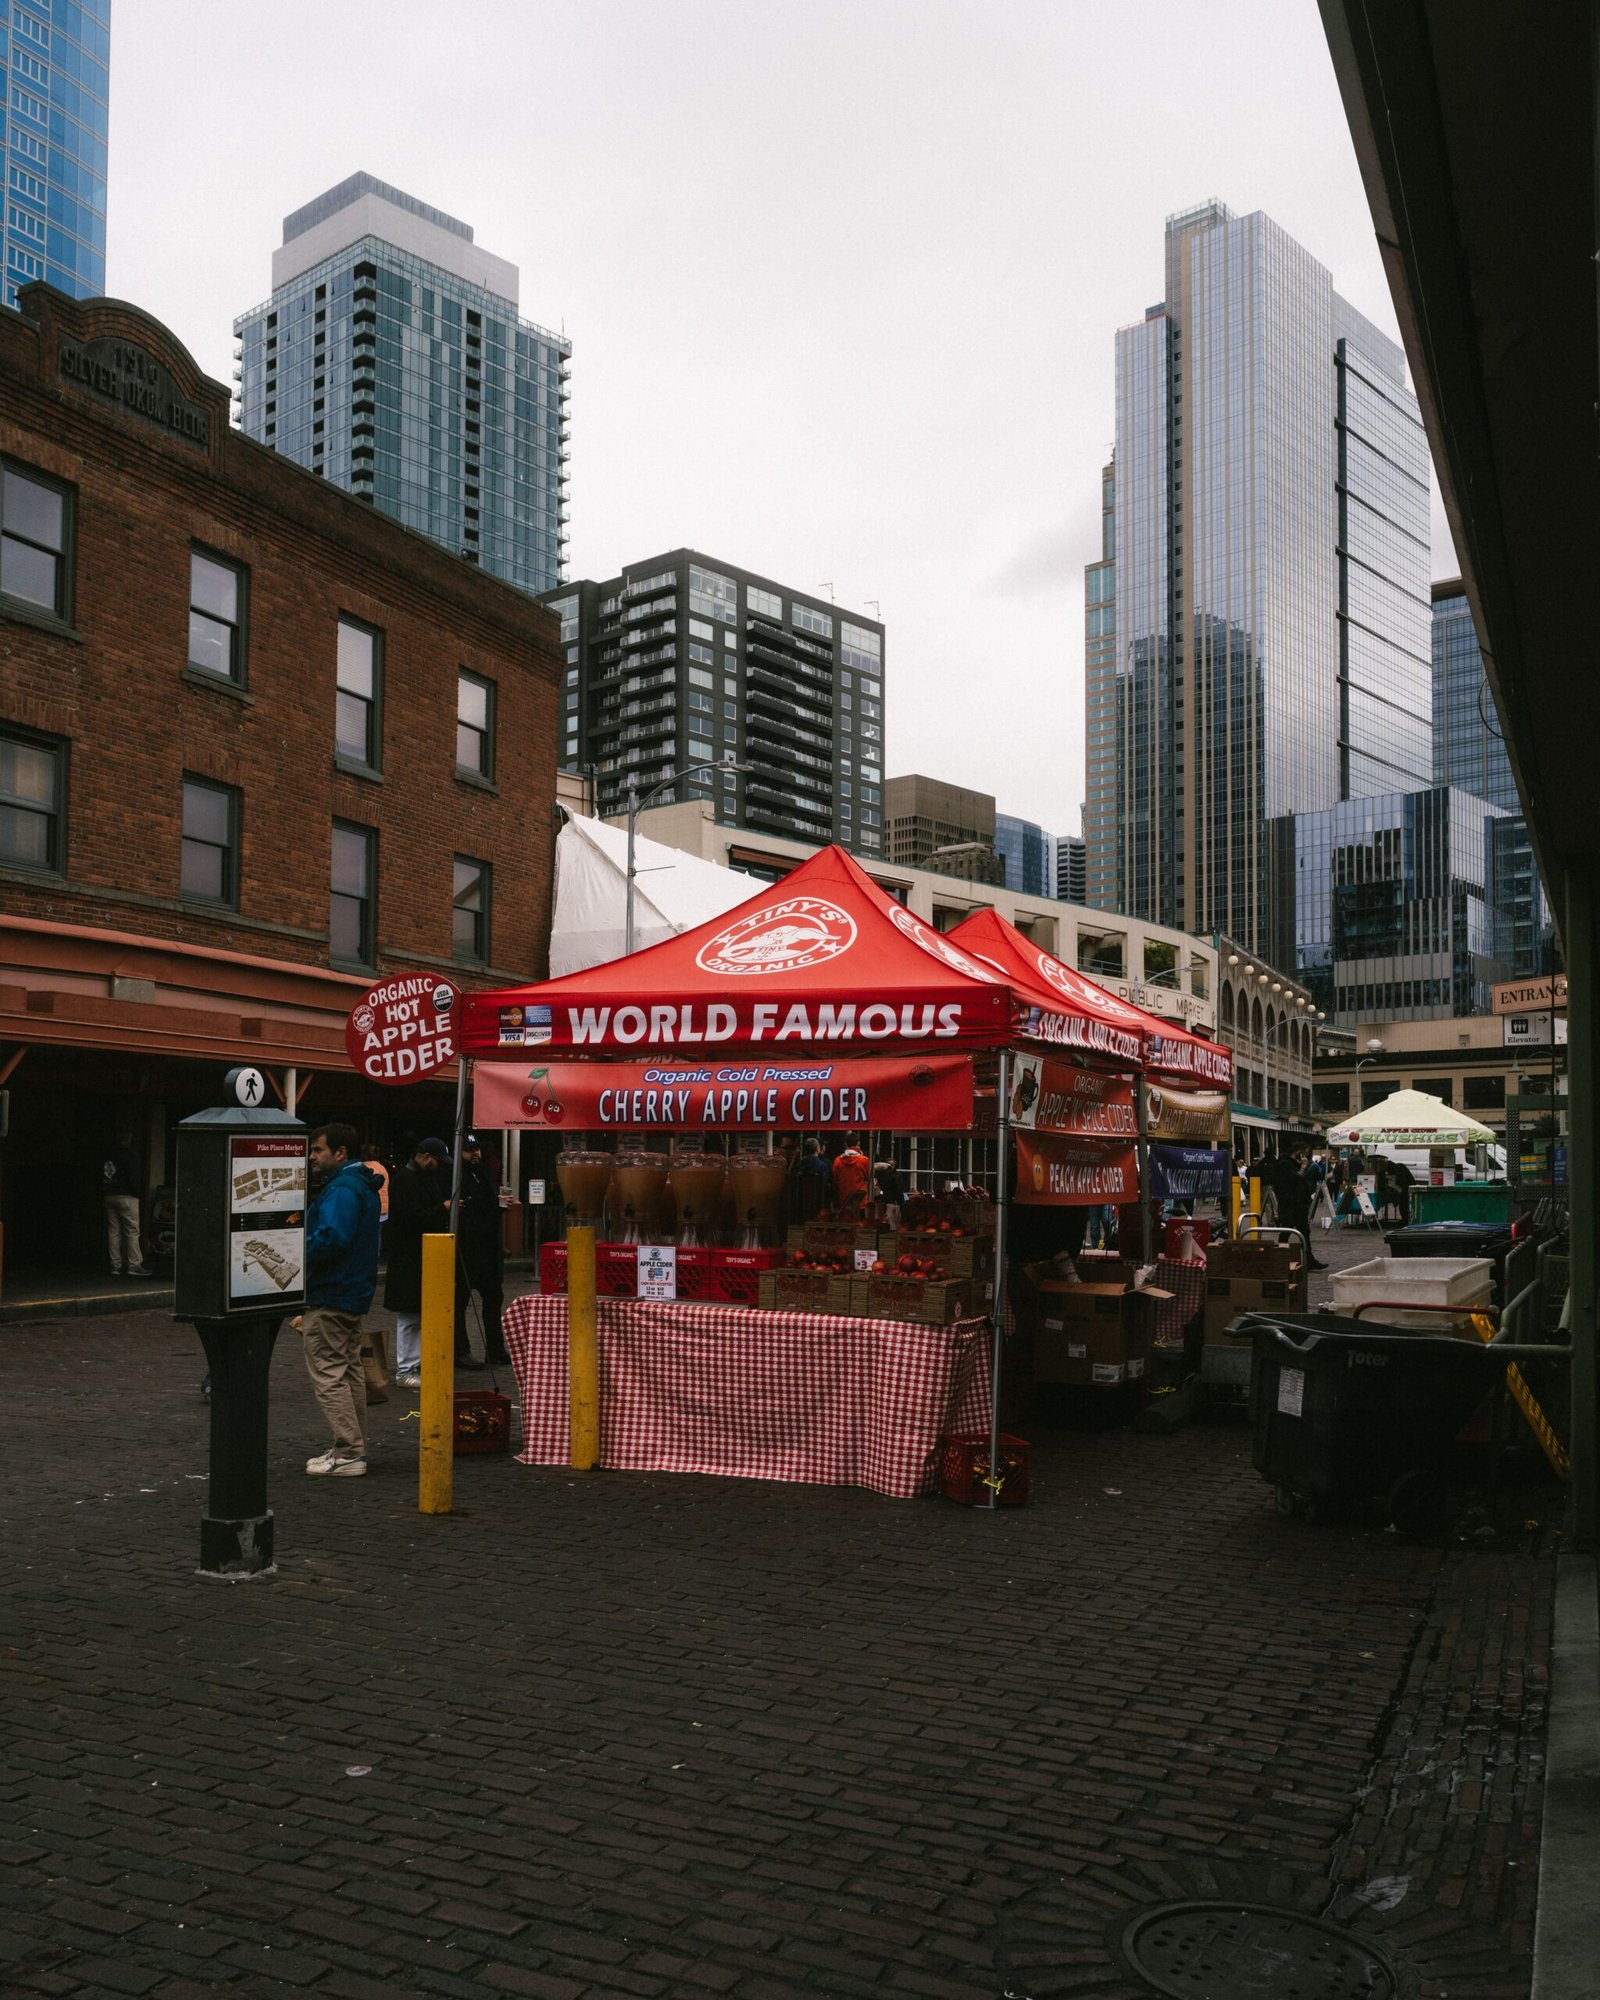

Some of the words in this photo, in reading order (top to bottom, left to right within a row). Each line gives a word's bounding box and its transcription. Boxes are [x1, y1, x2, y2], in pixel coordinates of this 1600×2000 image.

[64, 346, 121, 402] SILVER
[172, 402, 208, 443] BLDG
[705, 955, 815, 973] ORGANIC
[368, 978, 433, 1007] ORGANIC
[436, 989, 449, 998] USDA
[385, 998, 420, 1024] HOT
[363, 1013, 452, 1052] APPLE
[504, 1033, 521, 1042] VISA
[526, 1030, 551, 1038] DISCOVER
[568, 1007, 738, 1045] WORLD
[750, 1004, 962, 1041] FAMOUS
[1038, 1012, 1091, 1048] ORGANIC
[1088, 1020, 1119, 1055] APPLE
[1115, 1032, 1143, 1063] CIDER
[1507, 1036, 1540, 1044] Elevator
[364, 1037, 455, 1077] CIDER
[1161, 1039, 1193, 1071] ORGANIC
[1194, 1045, 1213, 1078] APPLE
[1213, 1053, 1231, 1083] CIDER
[644, 1069, 711, 1085] Organic
[716, 1068, 759, 1081] Cold
[763, 1066, 833, 1081] Pressed
[1073, 1074, 1106, 1096] ORGANIC
[598, 1089, 691, 1123] CHERRY
[702, 1088, 779, 1122] APPLE
[791, 1087, 868, 1122] CIDER
[1037, 1091, 1072, 1128] APPLE
[1082, 1100, 1108, 1132] SPICE
[1107, 1103, 1137, 1133] CIDER
[1164, 1107, 1183, 1134] HOT
[257, 1143, 269, 1151] Pike
[1360, 1133, 1458, 1143] SLUSHIES
[1049, 1163, 1077, 1193] PEACH
[1077, 1166, 1101, 1194] APPLE
[1102, 1167, 1125, 1193] CIDER
[1347, 1349, 1389, 1368] Toter
